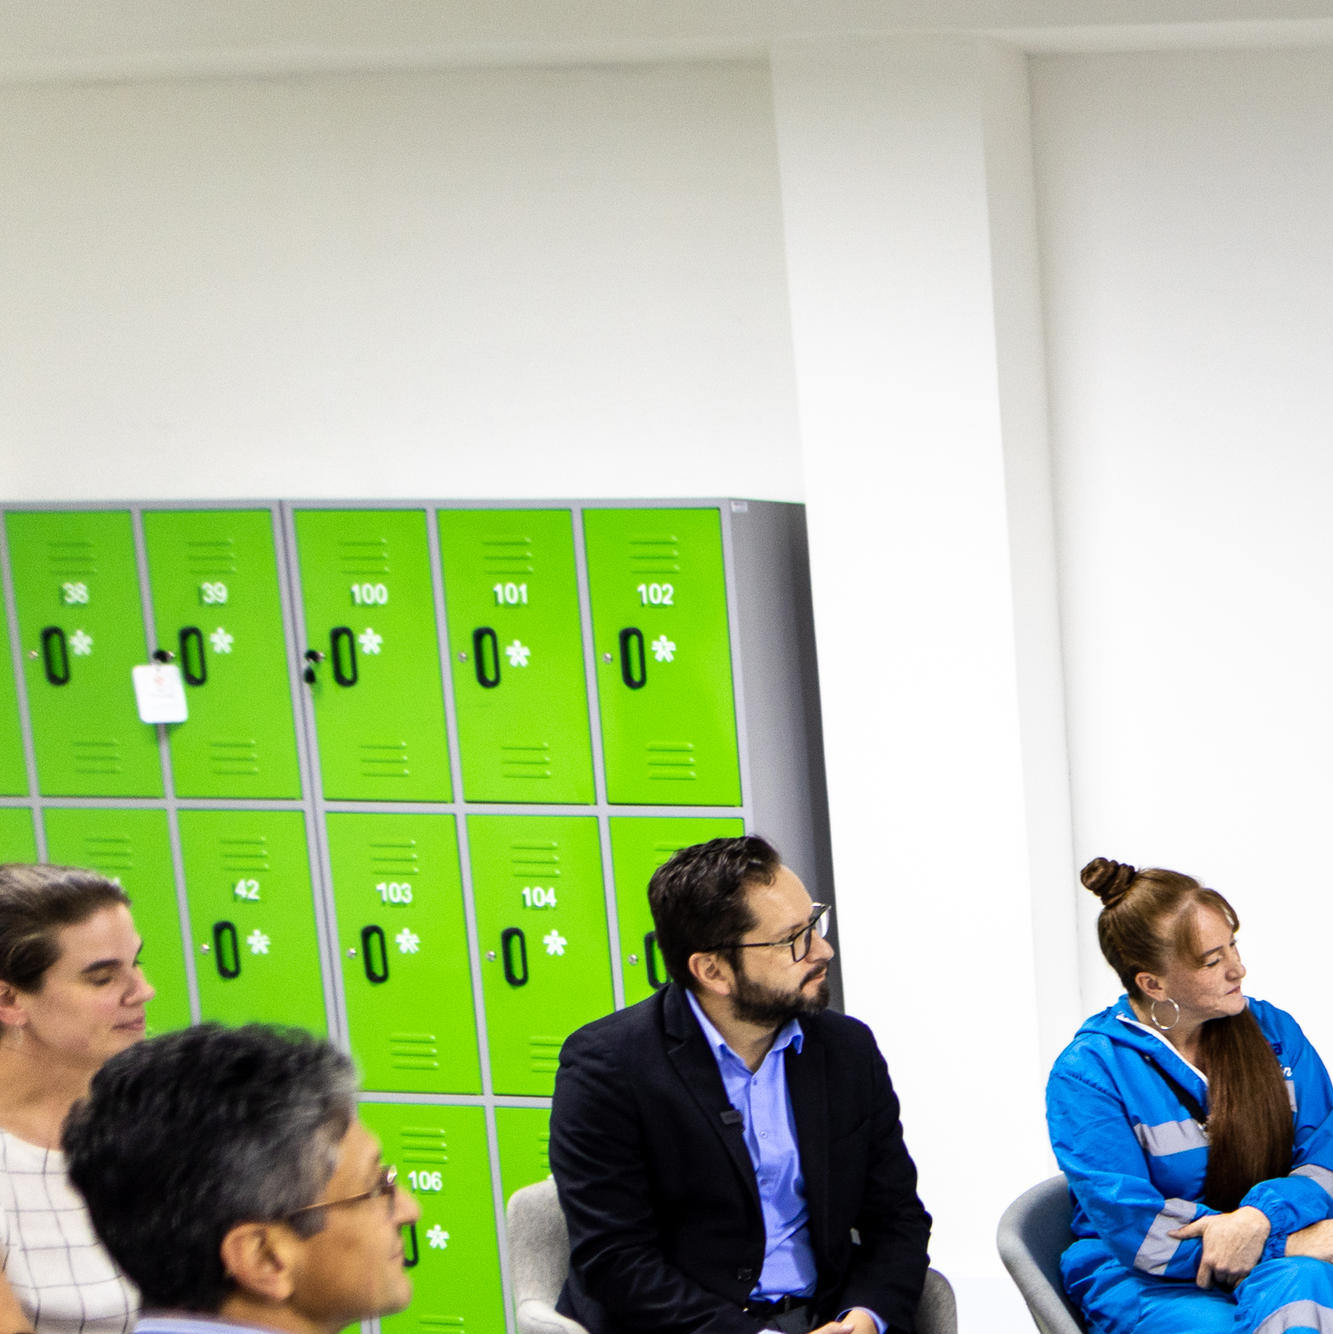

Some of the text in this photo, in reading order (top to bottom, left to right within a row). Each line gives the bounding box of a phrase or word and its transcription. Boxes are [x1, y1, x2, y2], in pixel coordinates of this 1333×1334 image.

[62, 582, 89, 604] 38
[201, 582, 229, 604] 39
[350, 582, 389, 605] 100
[492, 582, 529, 605] 101
[636, 582, 675, 606] 102
[234, 879, 260, 900] 42
[375, 881, 414, 904] 103
[521, 885, 558, 908] 104
[407, 1170, 443, 1192] 106
